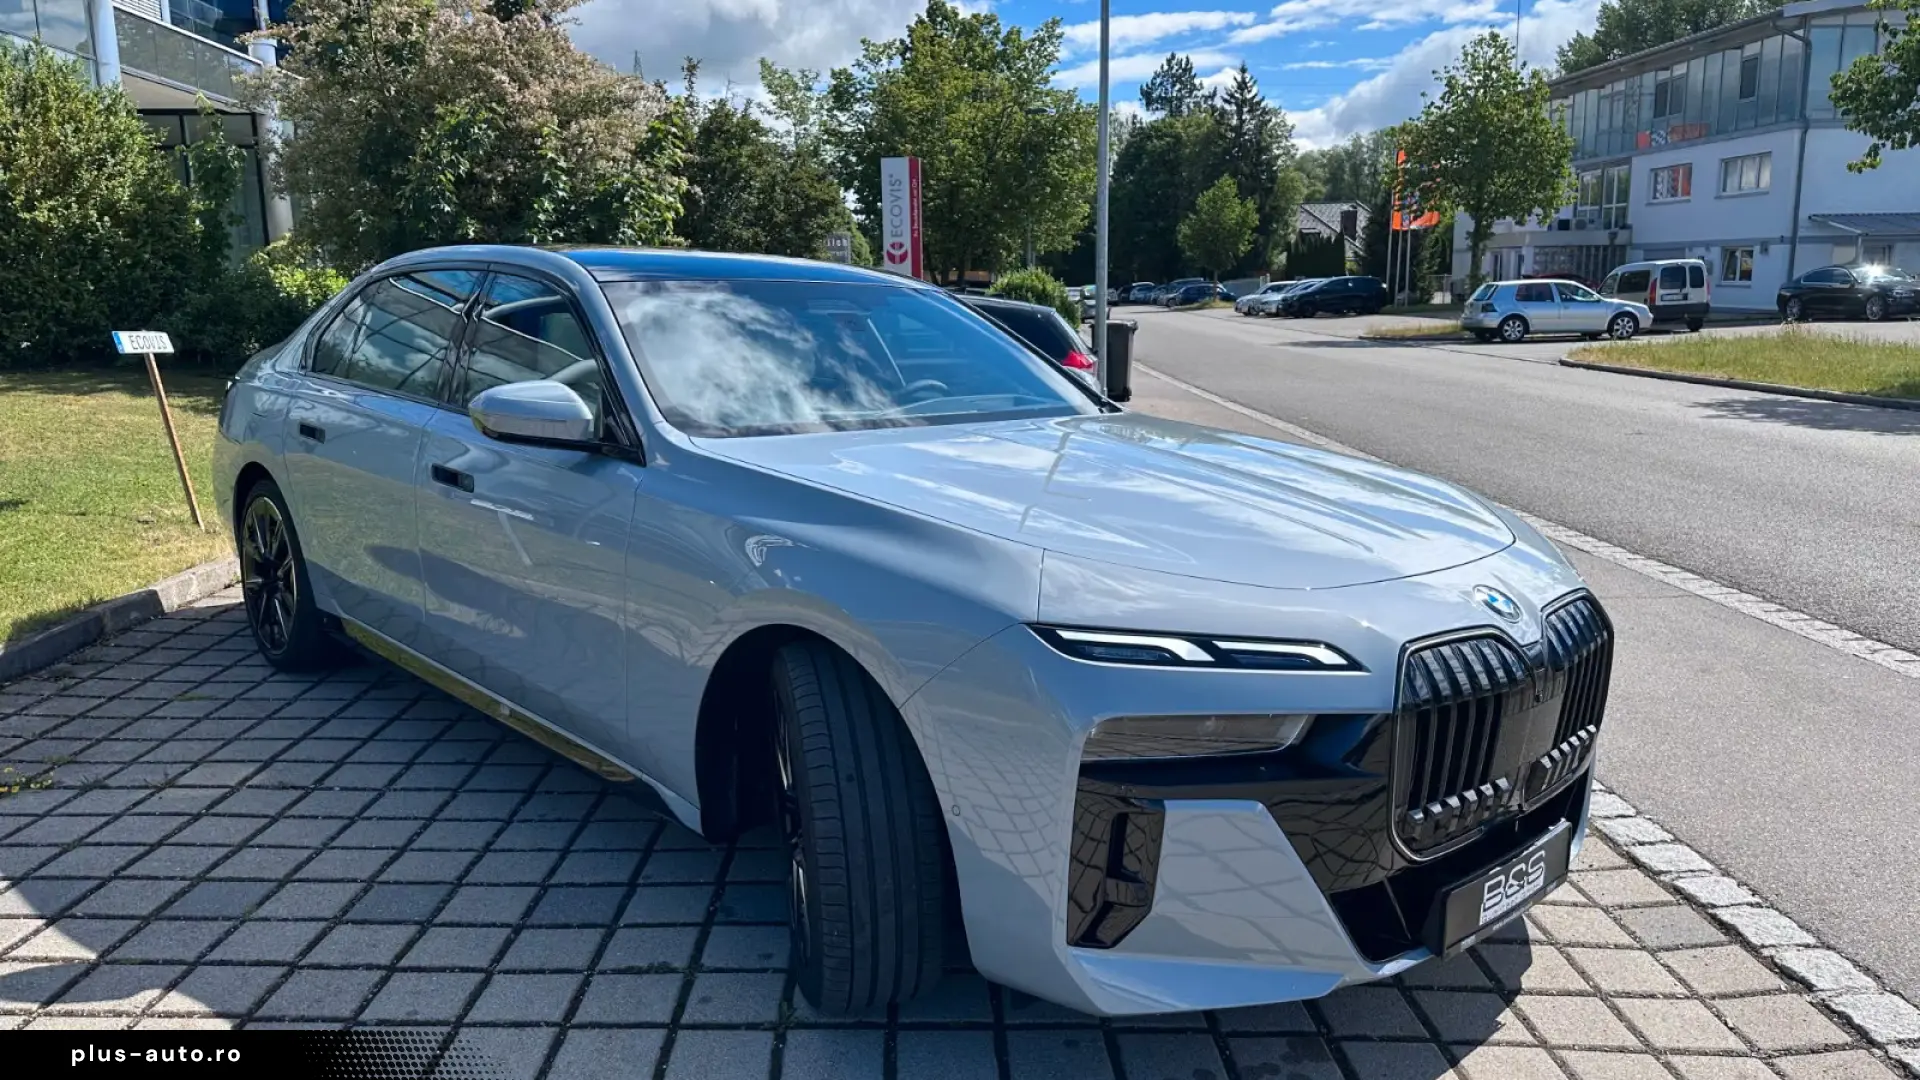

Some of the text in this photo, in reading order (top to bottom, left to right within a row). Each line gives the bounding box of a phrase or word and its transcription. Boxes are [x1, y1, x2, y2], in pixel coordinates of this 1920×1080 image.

[889, 178, 904, 237] ECOVIS
[128, 335, 168, 350] ECOVIS
[1483, 850, 1546, 912] B&S
